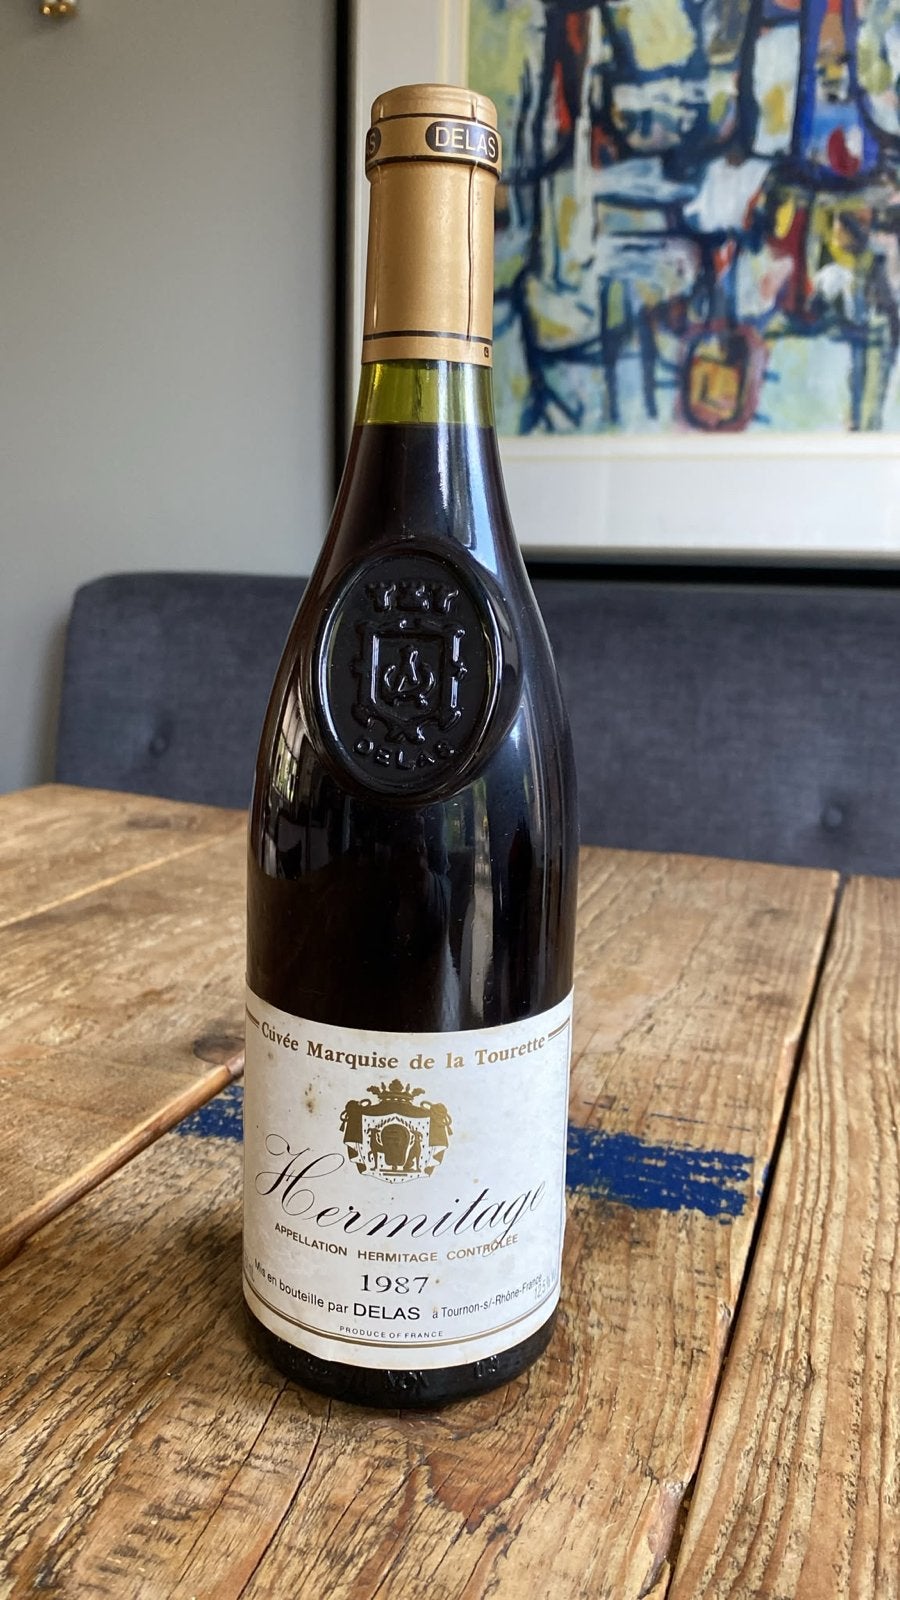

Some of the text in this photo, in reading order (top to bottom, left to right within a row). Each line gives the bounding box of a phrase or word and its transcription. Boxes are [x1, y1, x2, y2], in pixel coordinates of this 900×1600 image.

[435, 126, 496, 159] DELAS
[261, 1021, 545, 1070] Cuvée Marquise de la Tourette
[254, 1133, 546, 1258] Hermitage
[274, 1222, 348, 1257] APPELLATION
[357, 1250, 438, 1263] HERMITAGE
[254, 1258, 266, 1278] Mis
[267, 1272, 277, 1287] en
[279, 1279, 324, 1308] bouteille
[328, 1301, 348, 1313] par
[353, 1302, 420, 1321] DELAS
[360, 1274, 429, 1295] 1987
[339, 1325, 443, 1339] PRODUCE OF FRANCE
